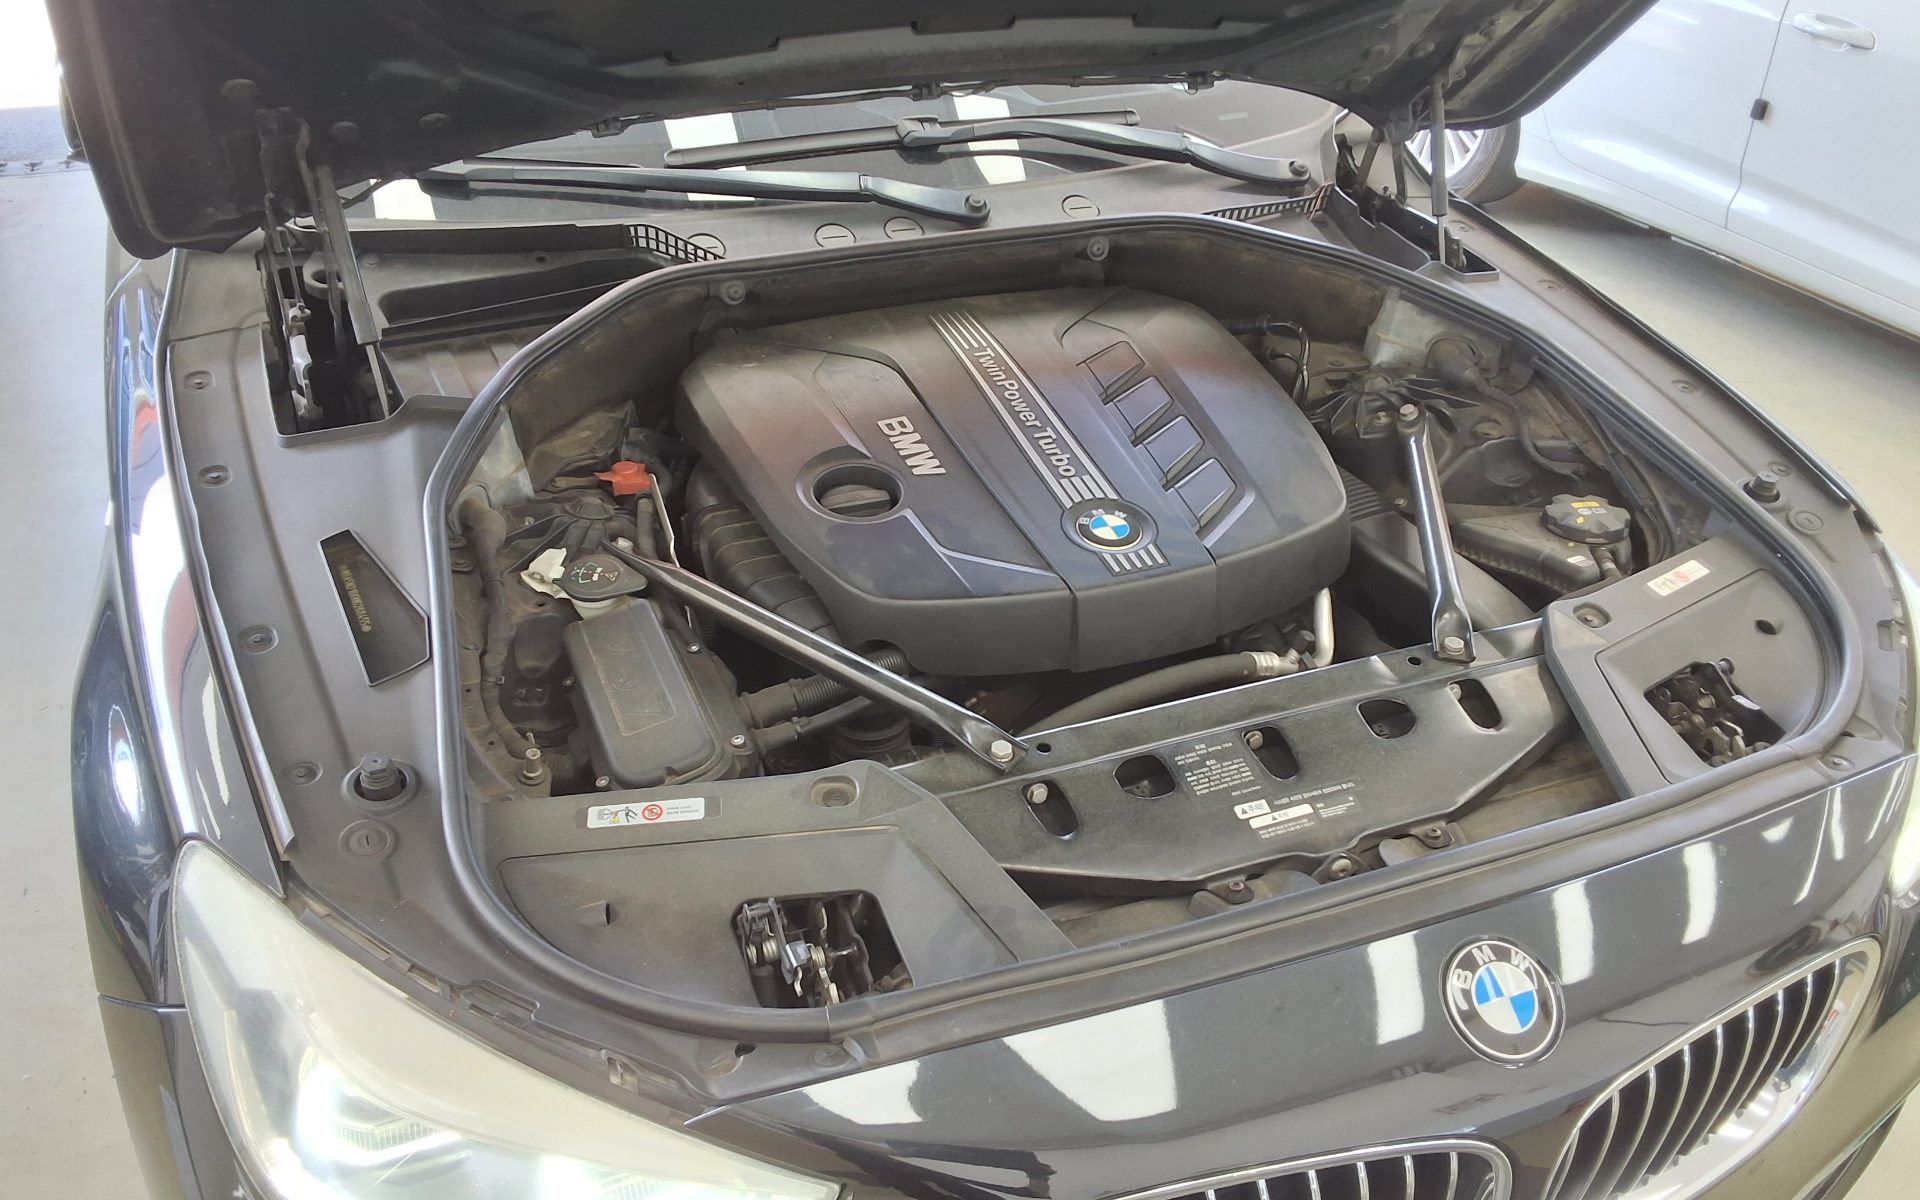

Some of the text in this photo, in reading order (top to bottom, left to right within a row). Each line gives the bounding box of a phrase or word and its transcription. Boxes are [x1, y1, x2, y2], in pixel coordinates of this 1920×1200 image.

[974, 347, 1076, 477] TwinPower Turbo
[877, 416, 947, 475] BMW
[1079, 508, 1127, 525] BMW
[1451, 944, 1530, 989] BMW
